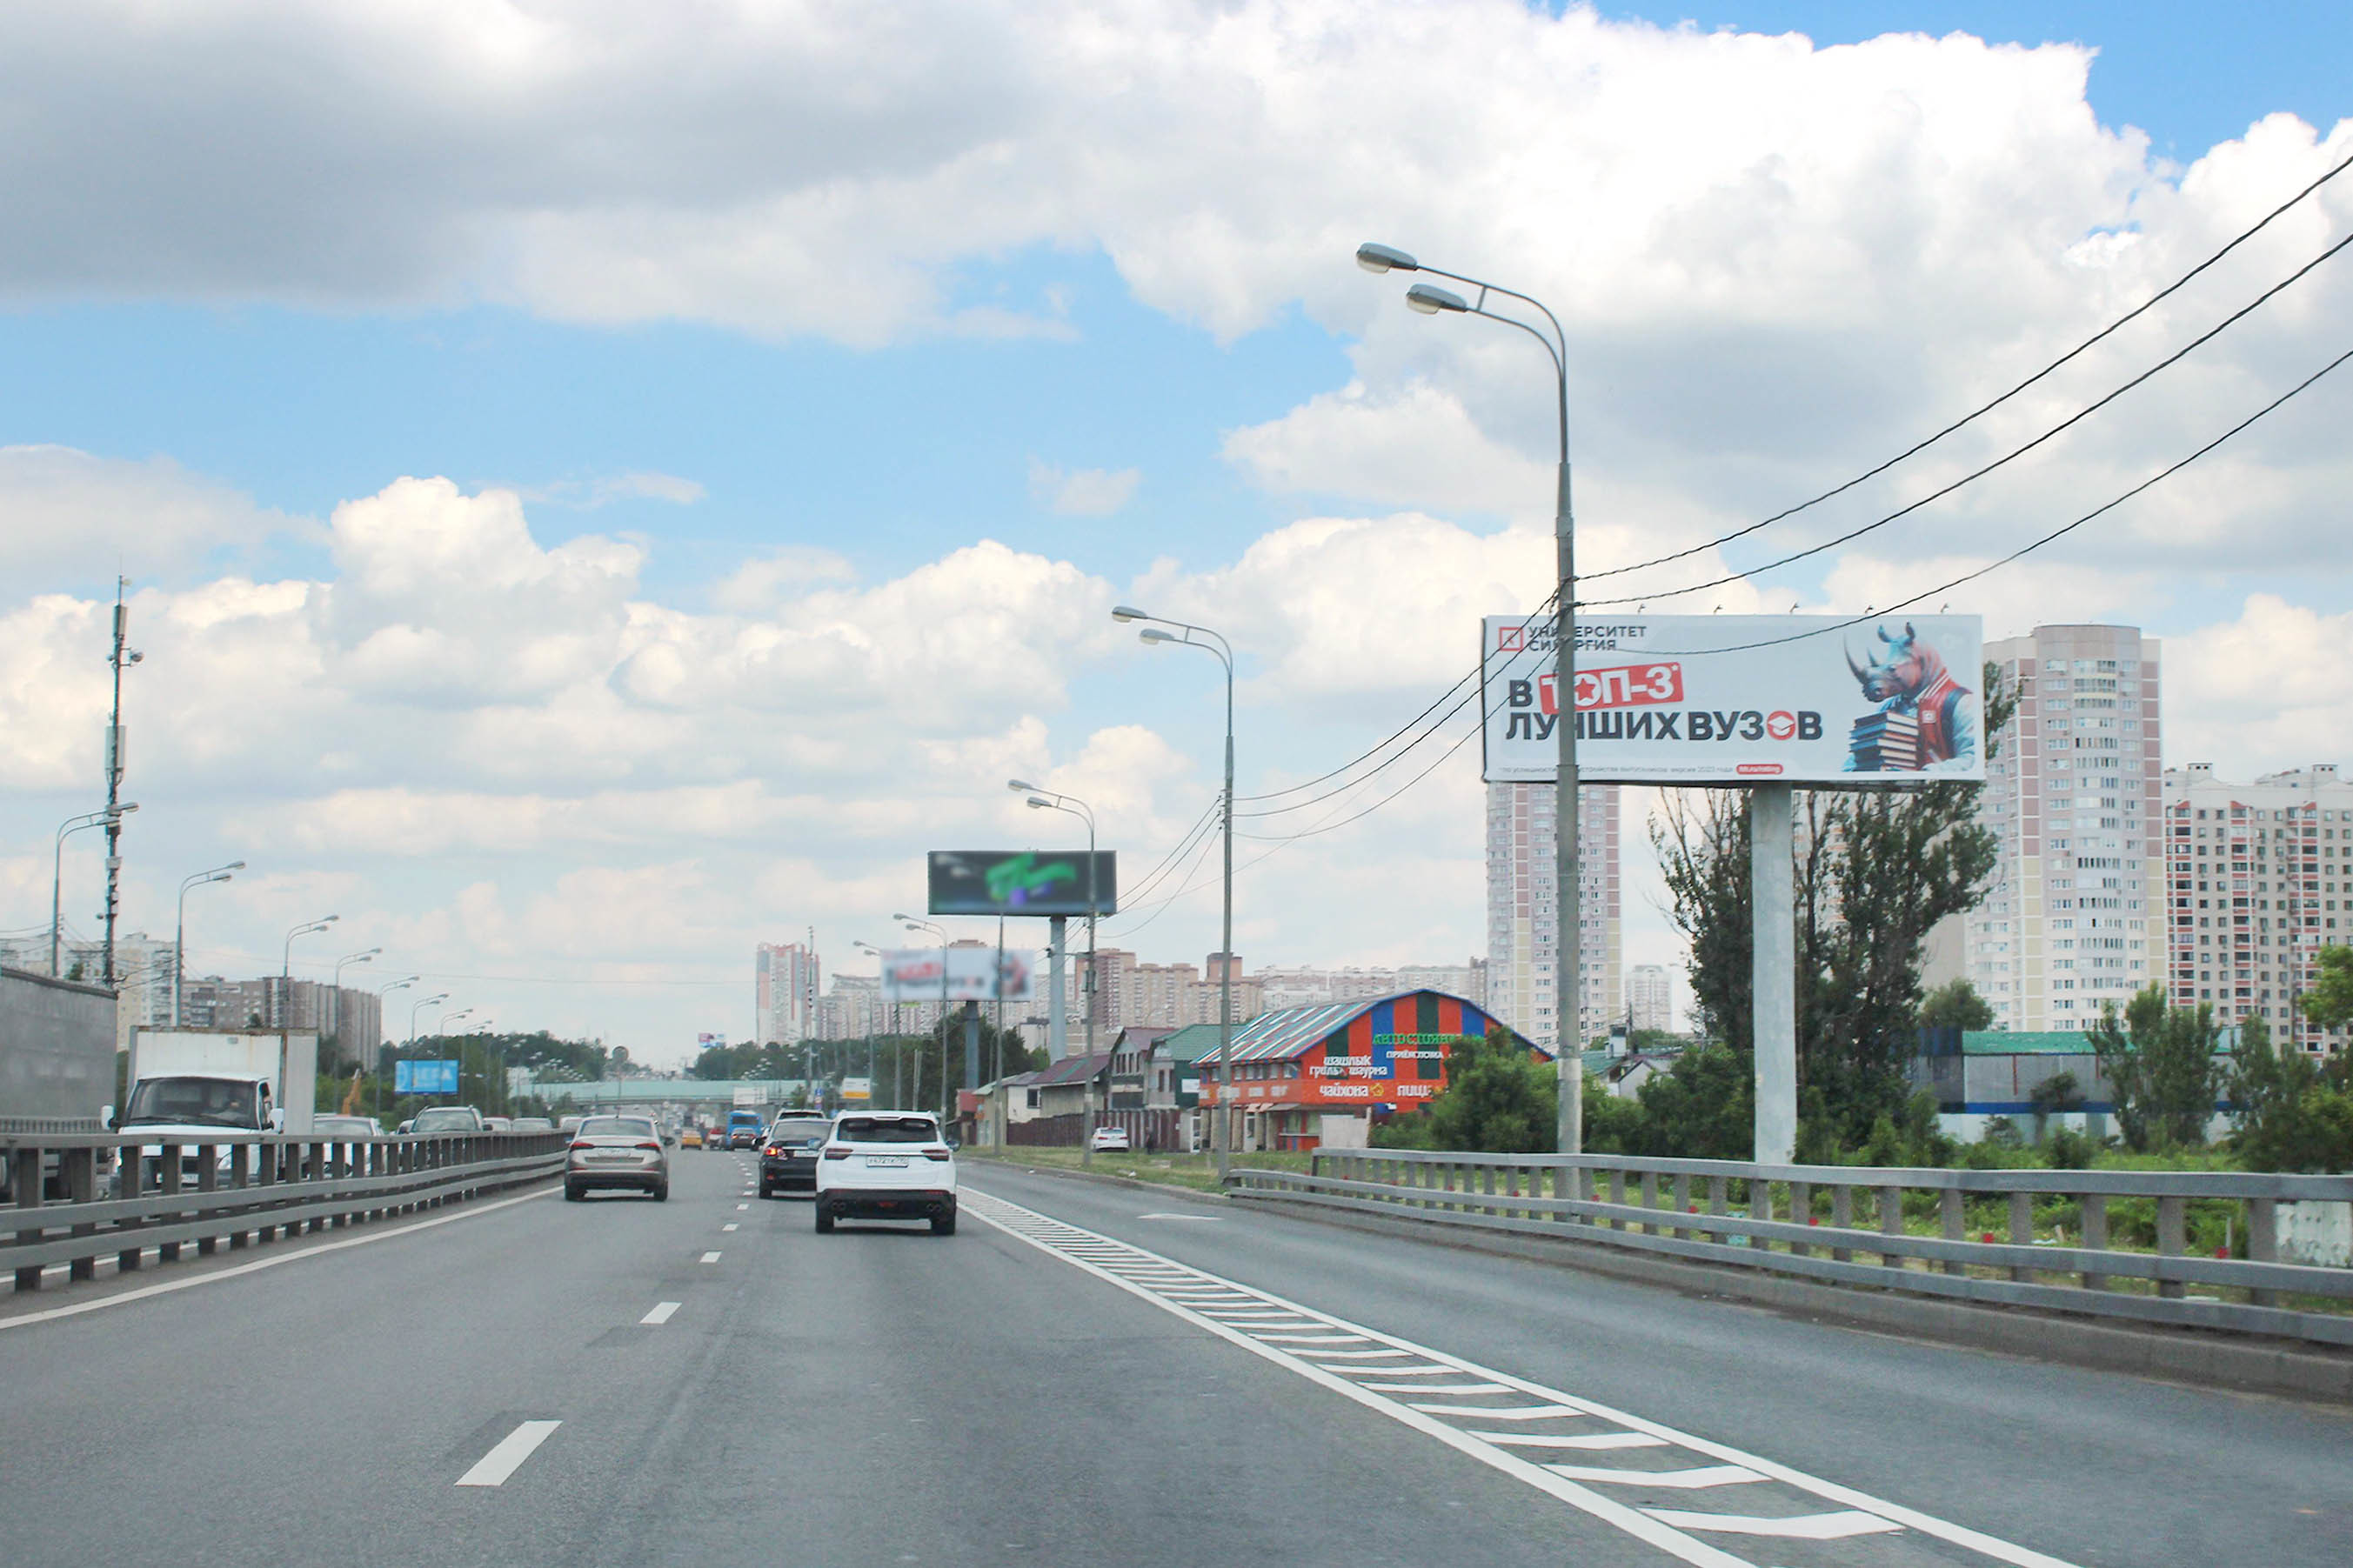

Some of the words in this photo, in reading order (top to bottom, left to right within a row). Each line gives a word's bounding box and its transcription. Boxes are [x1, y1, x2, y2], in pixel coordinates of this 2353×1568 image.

[1528, 625, 1647, 638] УНИЕРСИТЕТ
[1527, 639, 1616, 651] СИНРГИЯ
[1509, 679, 1533, 707] В
[1688, 711, 1823, 741] ВУЗОВ
